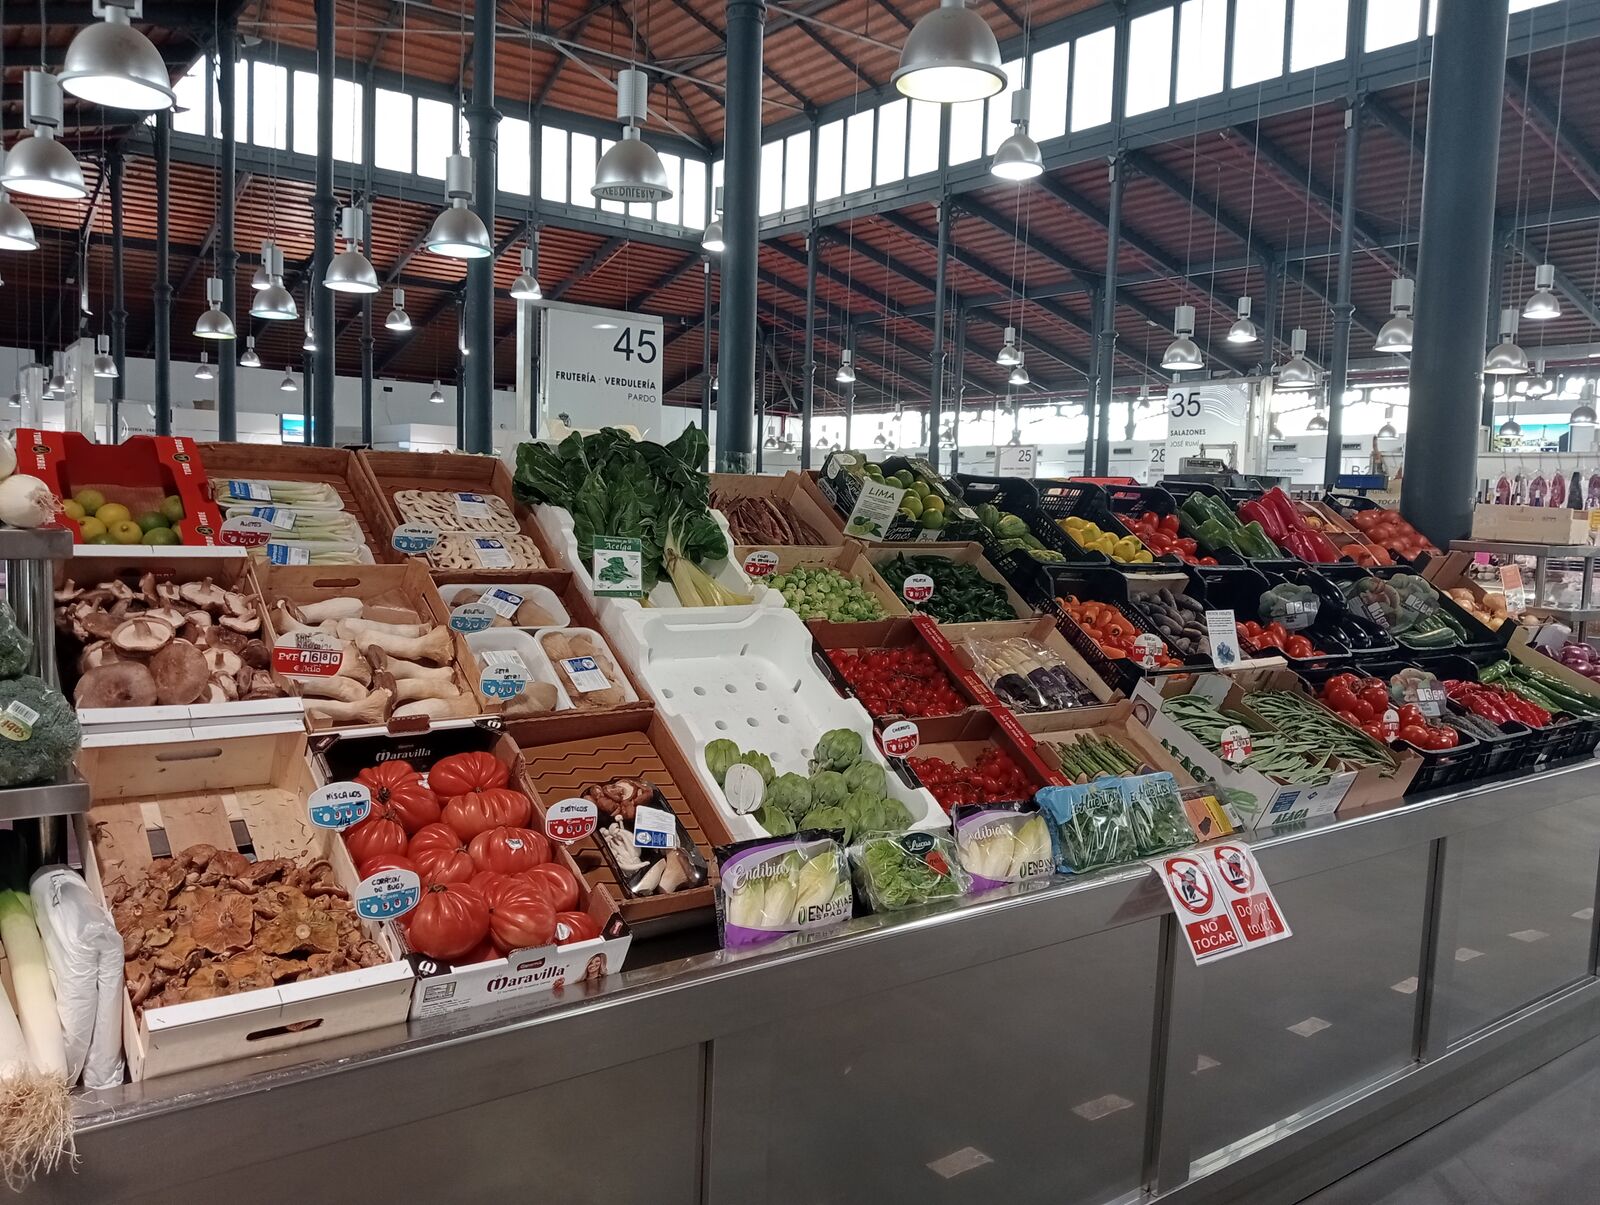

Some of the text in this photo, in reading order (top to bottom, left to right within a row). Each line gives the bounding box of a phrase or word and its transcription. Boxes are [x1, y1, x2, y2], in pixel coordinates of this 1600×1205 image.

[614, 327, 657, 364] 45
[555, 370, 656, 390] FRUTERÍA VERDULERÍA
[627, 392, 656, 403] PARDO
[1171, 392, 1201, 417] 35
[1170, 429, 1206, 437] SALAZONES
[1018, 449, 1032, 462] 25
[868, 487, 896, 501] LIMA
[605, 543, 632, 552] Acelga
[375, 747, 431, 762] Maravilla
[909, 839, 931, 852] Lucas
[1237, 900, 1270, 918] Do not
[1200, 921, 1218, 935] NO
[1247, 918, 1277, 935] touch
[1194, 931, 1236, 950] TOCAR
[487, 965, 565, 993] Maravilla
